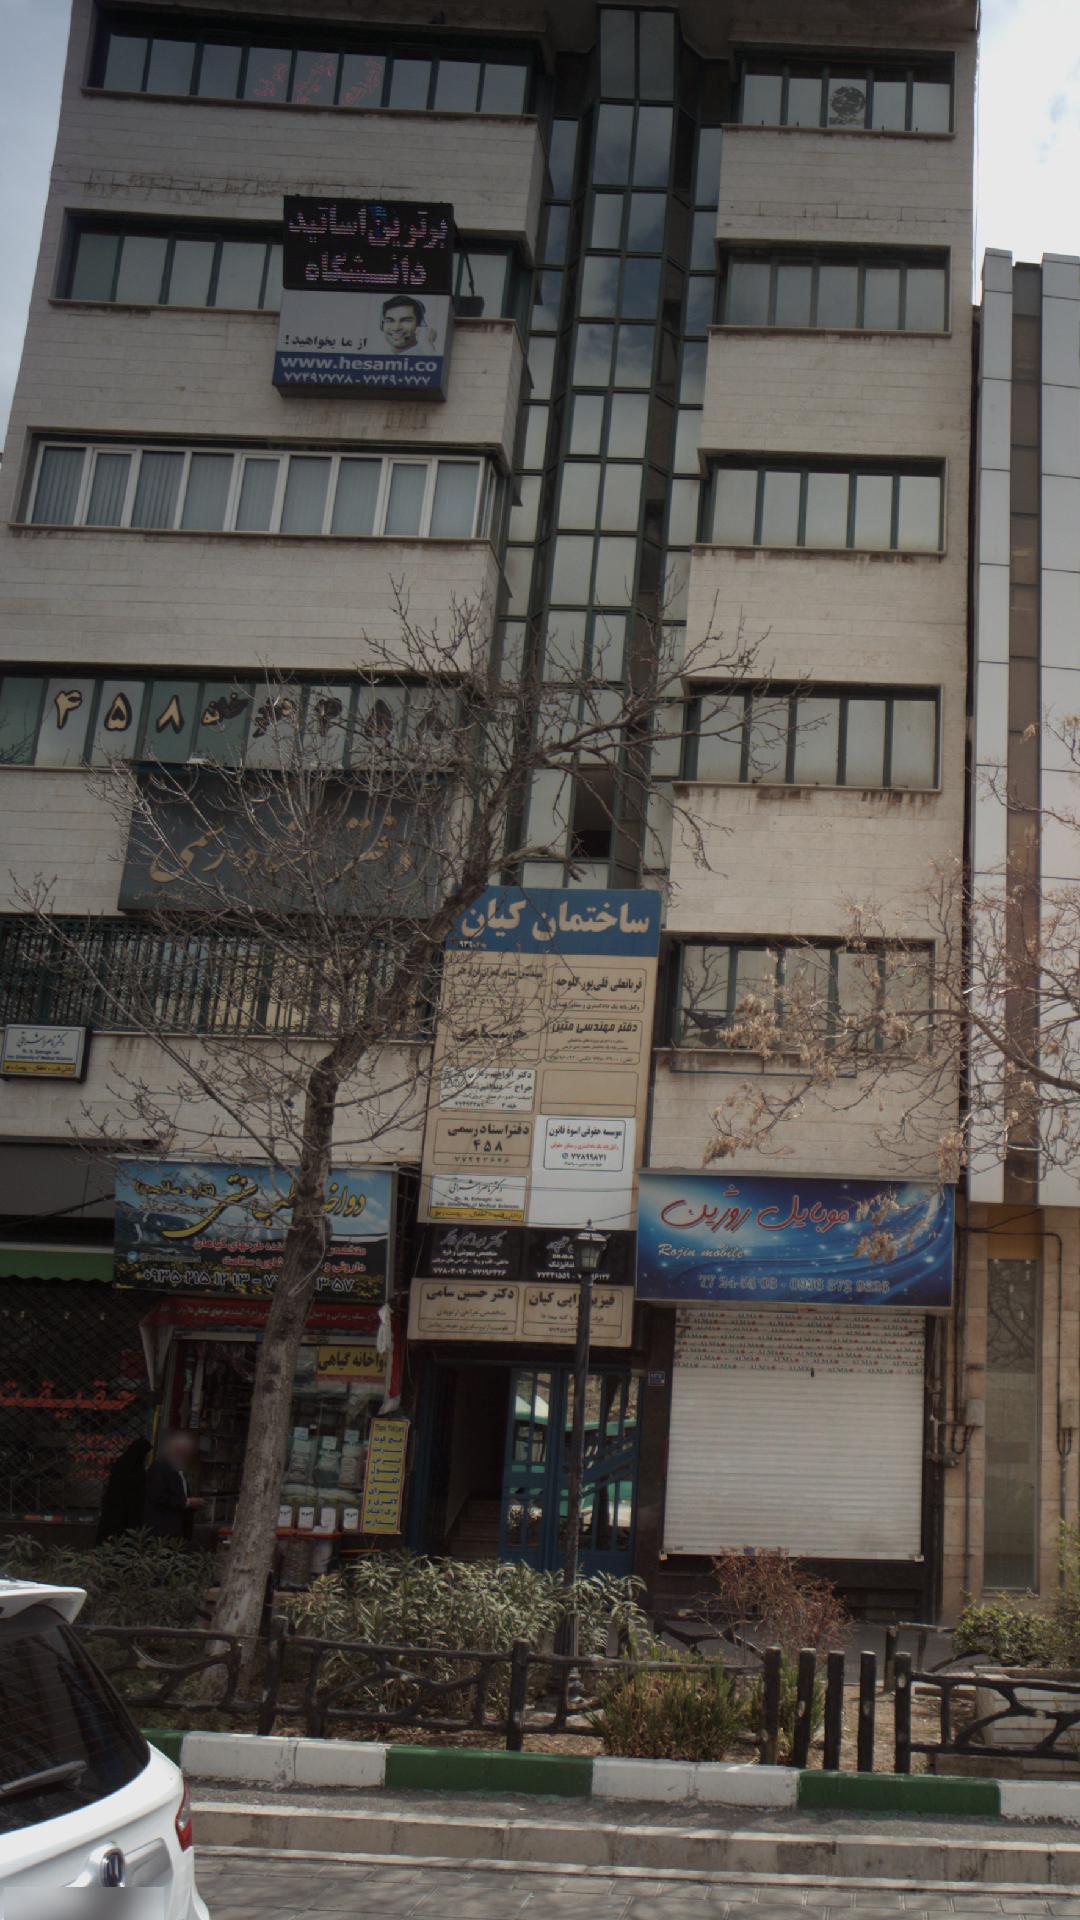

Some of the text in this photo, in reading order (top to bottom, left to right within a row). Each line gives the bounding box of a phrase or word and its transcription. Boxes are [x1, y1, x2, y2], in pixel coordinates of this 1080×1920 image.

[341, 337, 353, 348] ما
[357, 338, 368, 350] از
[280, 356, 437, 372] www.hesami.co
[461, 897, 650, 941] ساختمان کیان
[576, 1021, 615, 1034] مهندسی
[617, 1021, 638, 1033] دفتر
[448, 1123, 529, 1138] دفتر اسناد رسمی
[661, 1184, 849, 1233] موبایل روژین
[457, 1288, 488, 1301] حسین
[490, 1287, 514, 1302] دکتر
[318, 1351, 351, 1371] گیاهی
